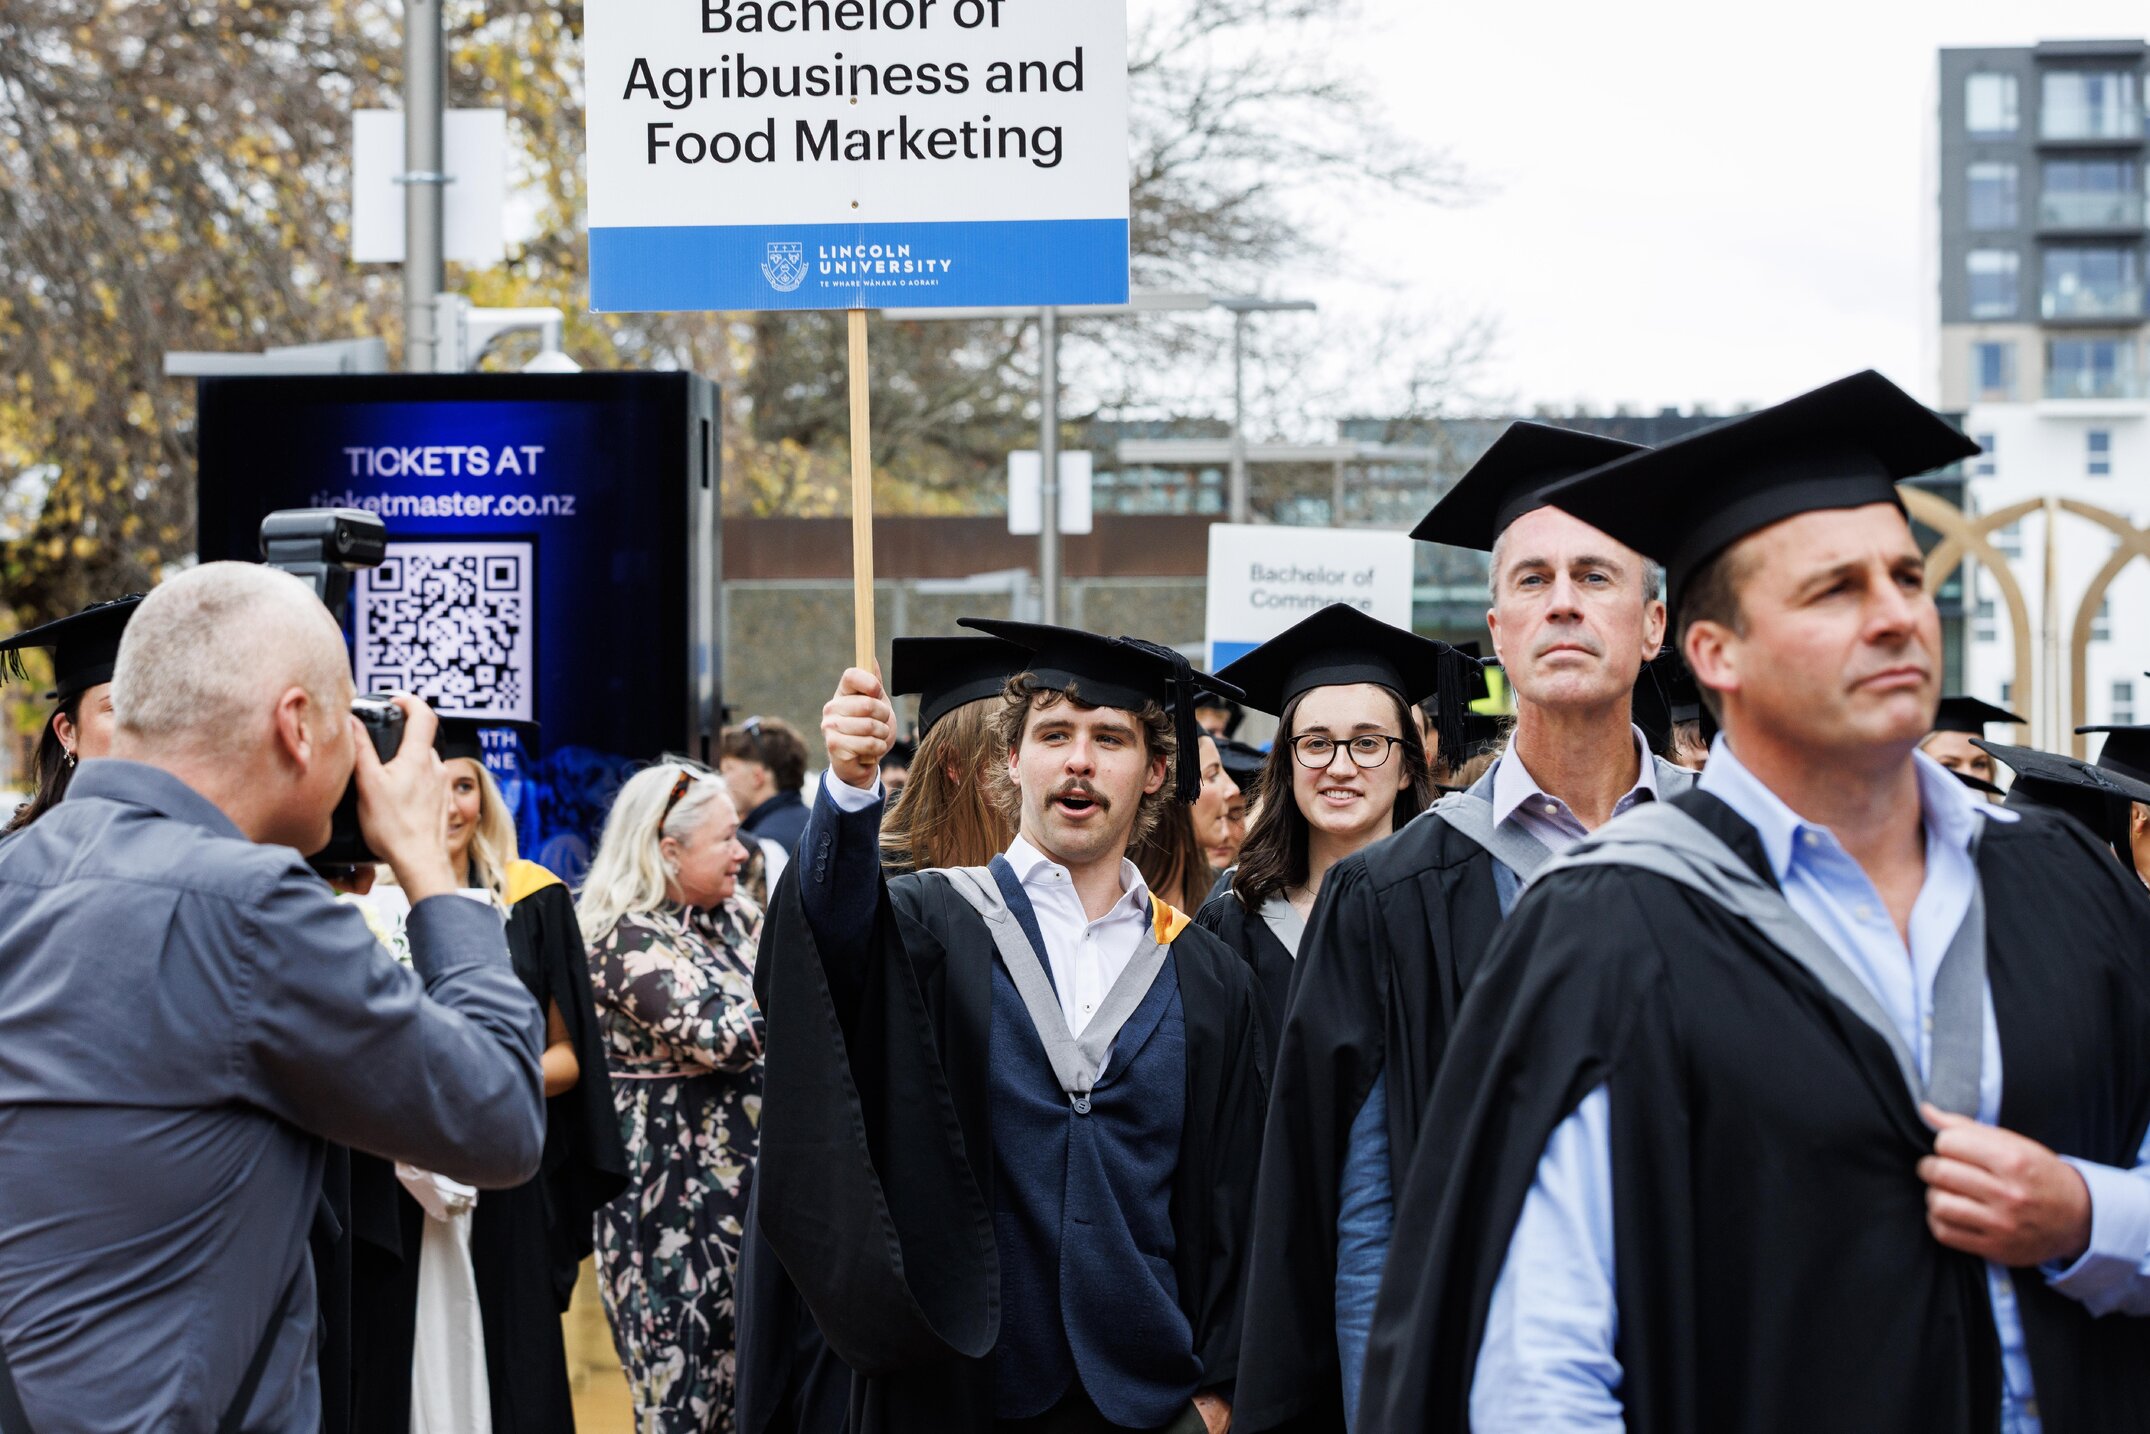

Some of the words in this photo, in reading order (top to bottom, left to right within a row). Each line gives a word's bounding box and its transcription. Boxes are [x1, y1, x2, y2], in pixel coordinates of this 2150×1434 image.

[701, 0, 937, 33] Bachelor
[953, 0, 1005, 29] of
[623, 52, 969, 109] Agribusiness
[985, 47, 1084, 93] and
[647, 118, 776, 164] Food
[796, 115, 1064, 168] Marketing
[819, 244, 910, 259] LINCOLN
[819, 259, 952, 274] UNIVERSITY
[832, 280, 861, 288] WHARE
[908, 279, 939, 287] AORAKI
[342, 446, 491, 476] TICKETS
[495, 446, 545, 476] AT
[1250, 563, 1346, 585] Bachelor
[1352, 566, 1375, 586] of
[477, 730, 517, 748] ITH
